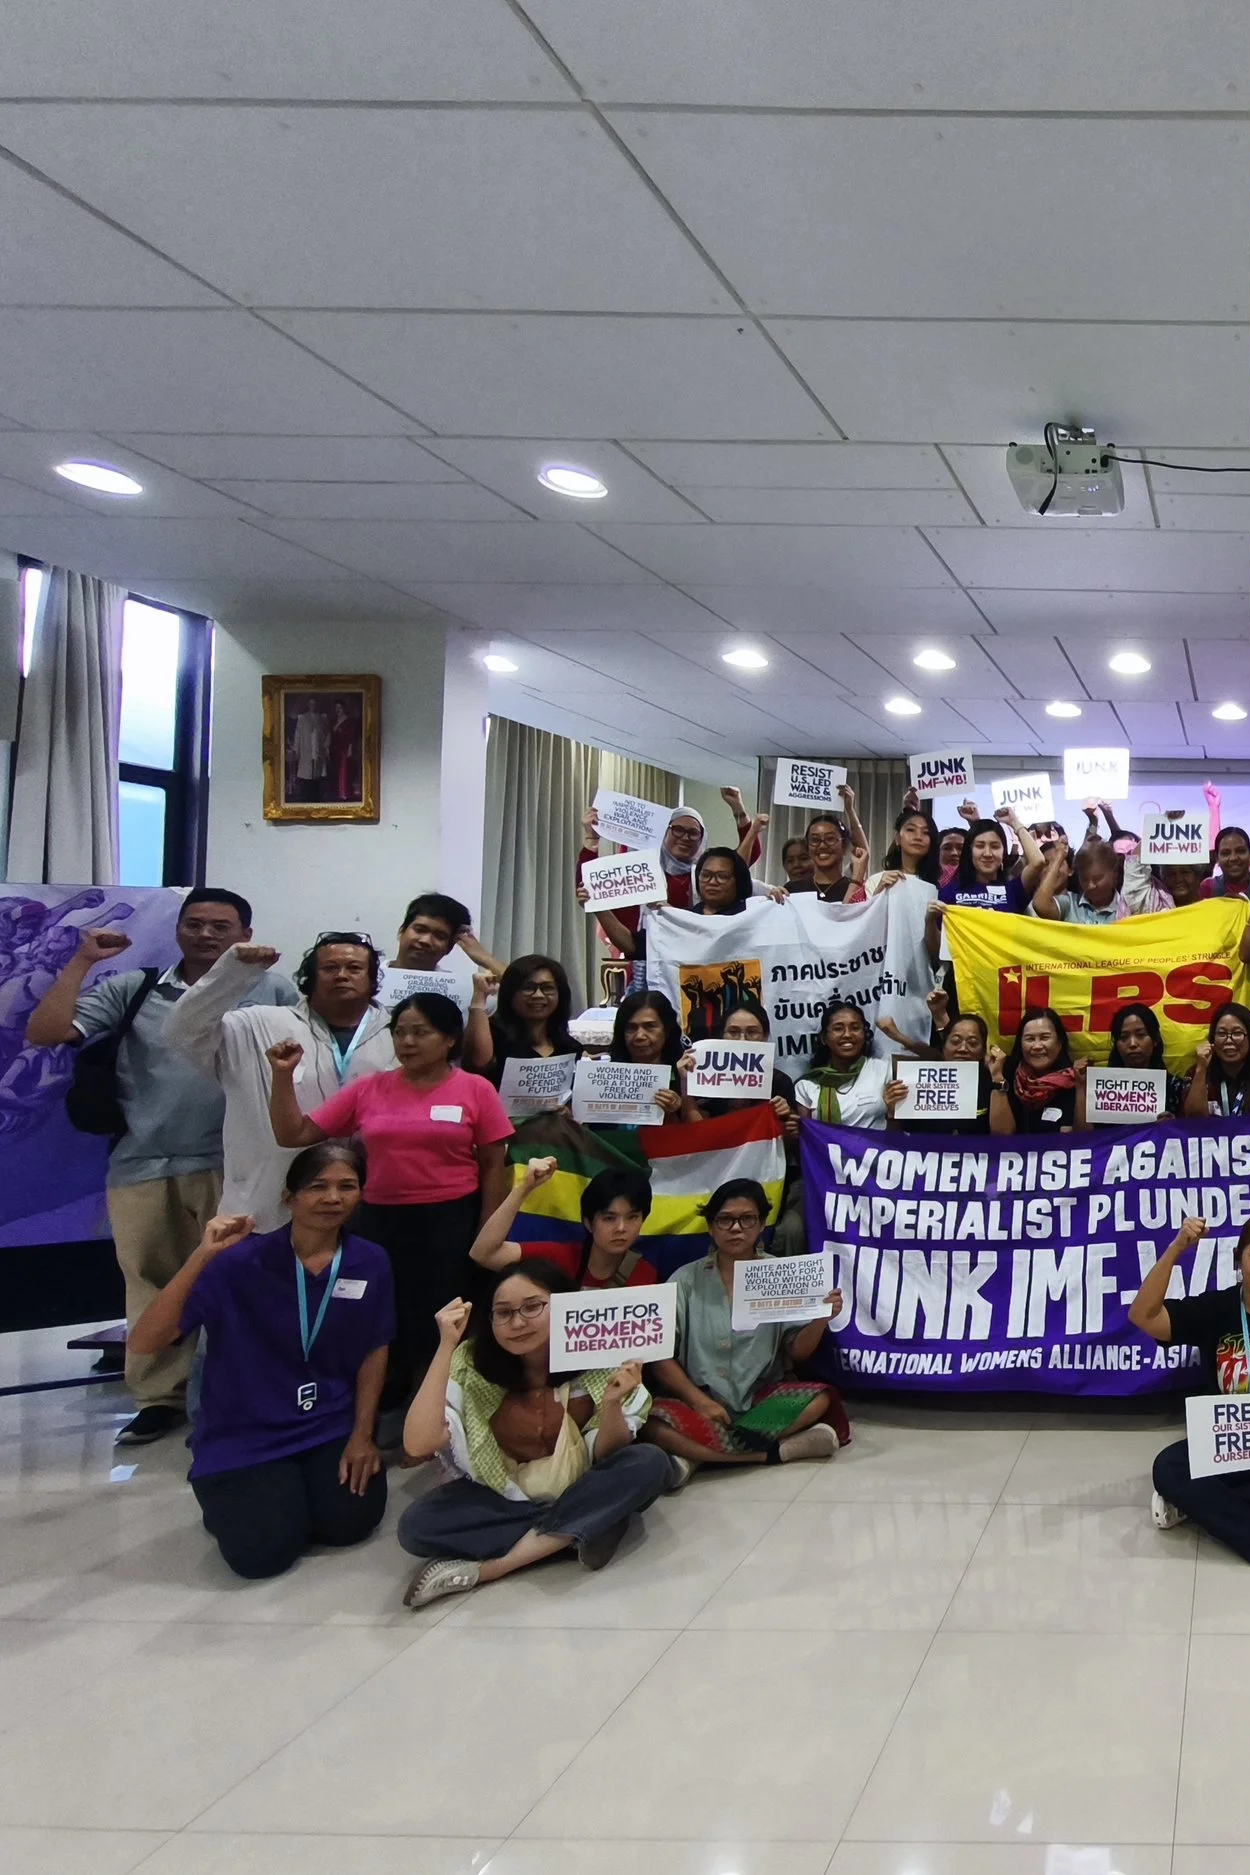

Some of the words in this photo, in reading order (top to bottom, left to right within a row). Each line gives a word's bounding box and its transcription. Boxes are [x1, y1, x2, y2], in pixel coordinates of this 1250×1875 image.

[791, 764, 834, 780] RESIST
[917, 757, 967, 778] JUNK
[791, 776, 810, 785] U.S.
[812, 778, 831, 787] LED
[917, 774, 967, 791] IMF-WB!
[788, 792, 832, 802] AGGRESSIONS
[790, 783, 820, 795] WARS
[823, 787, 831, 796] &
[1000, 787, 1043, 806] JUNK
[1150, 823, 1203, 841] JUNK
[1149, 842, 1201, 853] IMF-WB!
[590, 866, 622, 882] FIGHT
[626, 863, 649, 875] FOR
[591, 870, 654, 891] WOMEN'S
[593, 882, 657, 901] LIBERATION!
[771, 944, 887, 983] ภาคประชาช
[1026, 961, 1093, 972] INTERNATIONAL
[1096, 957, 1131, 969] LEAGUE
[1191, 951, 1232, 962] STRUGGLE
[519, 1064, 558, 1073] PROTECT
[697, 1051, 765, 1073] JUNK
[588, 1073, 632, 1081] CHILDREN
[596, 1066, 632, 1075] WOMEN
[633, 1068, 652, 1076] AND
[918, 1067, 958, 1084] FREE
[518, 1079, 556, 1087] DEFEND
[697, 1072, 763, 1087] IMF-WB!
[1096, 1079, 1129, 1091] FIGHT
[1132, 1080, 1155, 1092] FOR
[599, 1092, 644, 1100] VIOLENCE!
[917, 1090, 956, 1105] FREE
[1095, 1090, 1158, 1104] WOMEN'S
[914, 1103, 960, 1112] OURSELVES
[1095, 1102, 1158, 1113] LIBERATION!
[827, 1142, 989, 1193] WOMEN
[996, 1148, 1092, 1192] RISE
[824, 1190, 1077, 1241] IMPERIALIST
[744, 1269, 798, 1280] MILITANTLY
[799, 1266, 817, 1274] FOR
[746, 1264, 775, 1273] UNITE
[776, 1262, 796, 1270] AND
[799, 1259, 824, 1268] FIGHT
[745, 1281, 809, 1292] EXPLOITATION
[811, 1280, 824, 1288] OR
[746, 1277, 780, 1286] WORLD
[781, 1273, 824, 1284] WITHOUT
[760, 1288, 809, 1297] VIOLENCE!
[823, 1240, 998, 1341] JUNK
[566, 1307, 618, 1325] FIGHT
[623, 1303, 659, 1320] FOR
[564, 1317, 664, 1340] WOMEN'S
[565, 1333, 664, 1353] LIBERATION!
[841, 1347, 953, 1375] ERNATIONAL
[960, 1346, 1042, 1374] WOMENS
[1048, 1344, 1201, 1371] ALLIANCE-ASIA
[1212, 1424, 1233, 1433] OUR
